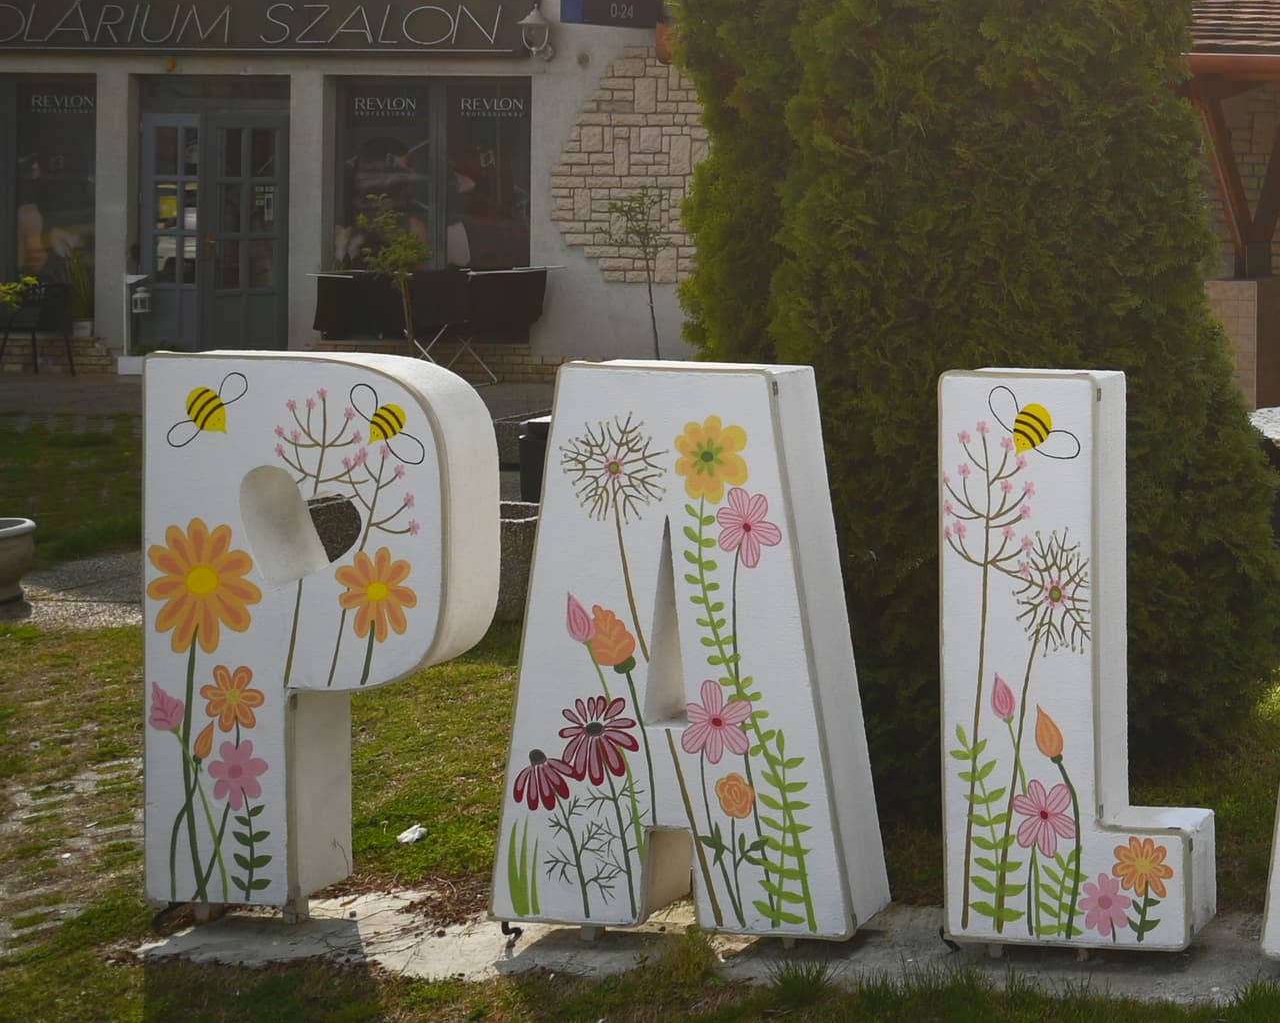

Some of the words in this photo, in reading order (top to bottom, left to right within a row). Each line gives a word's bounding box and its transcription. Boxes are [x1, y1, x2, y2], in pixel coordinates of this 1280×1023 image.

[609, 2, 634, 18] 0-24
[259, 3, 502, 45] SZALON
[32, 95, 96, 107] REVLON
[354, 97, 417, 110] REVLON
[460, 97, 524, 110] REVLON
